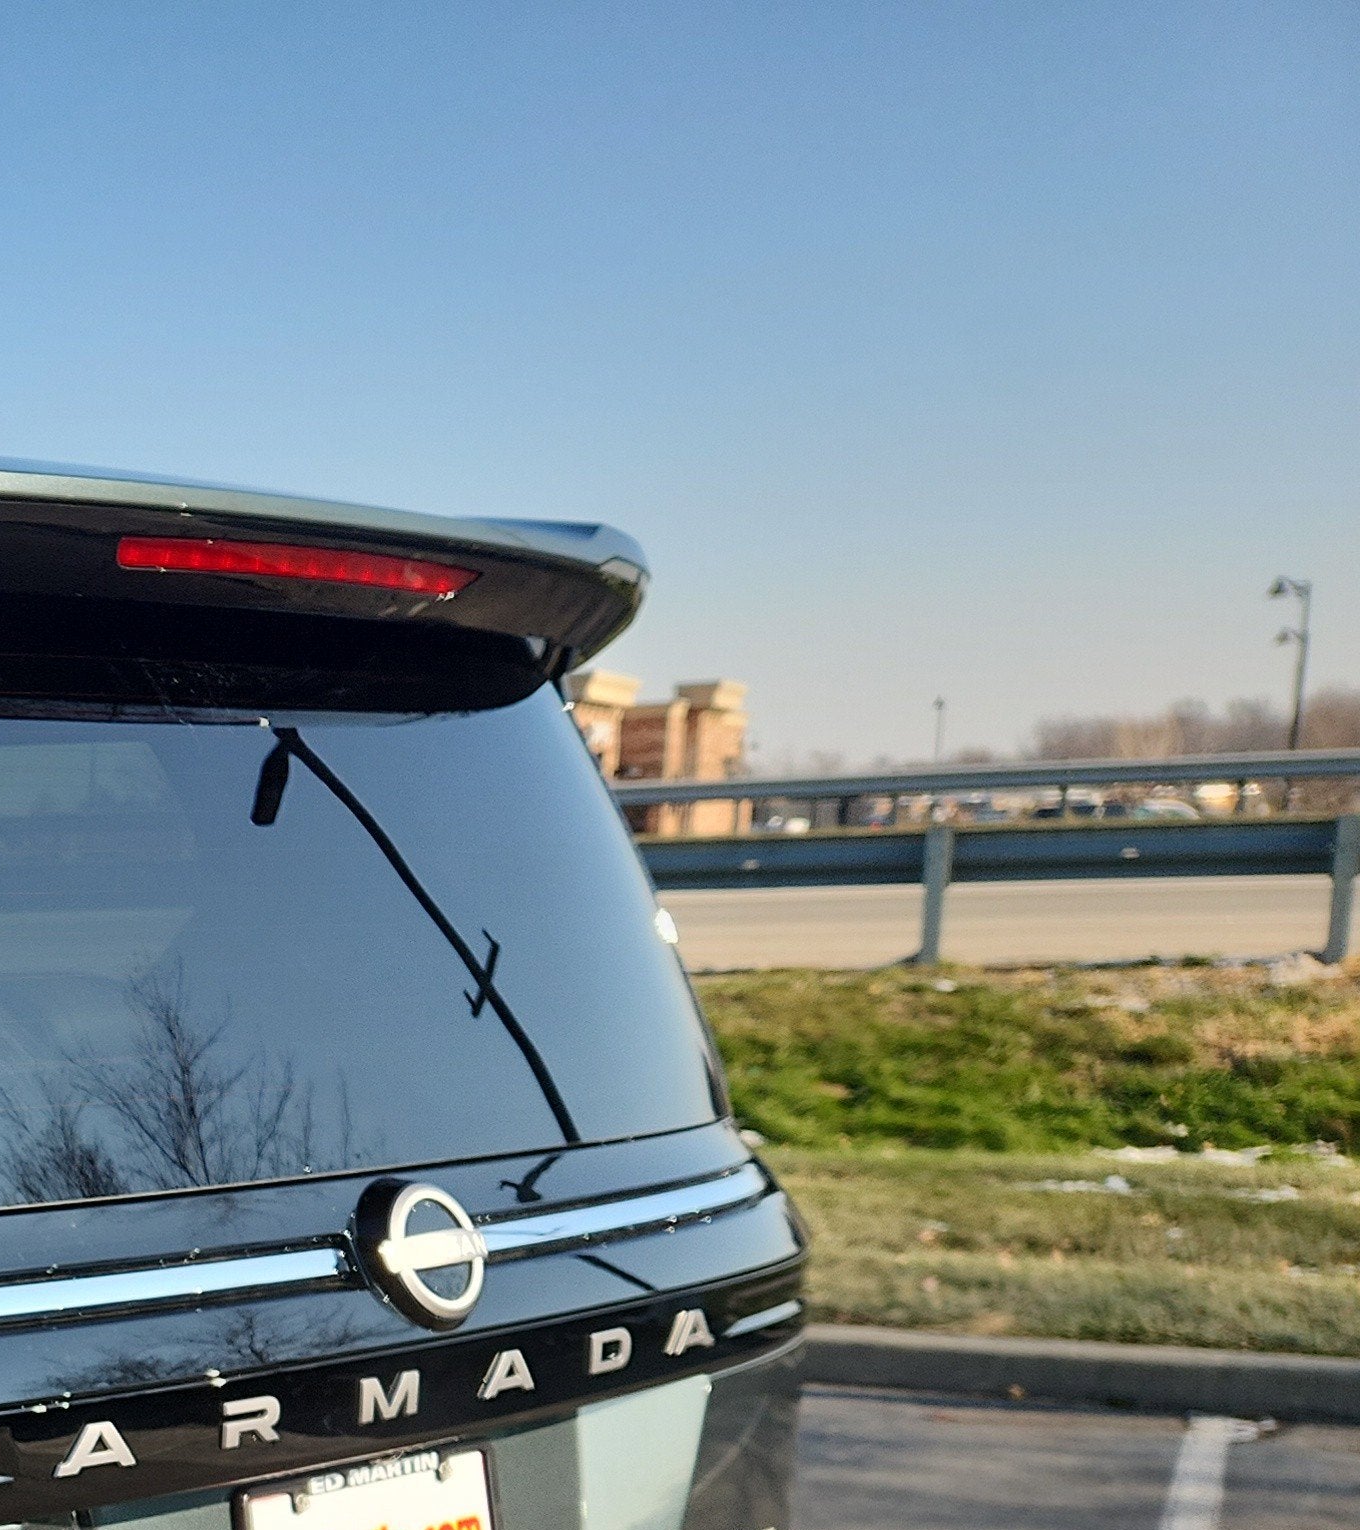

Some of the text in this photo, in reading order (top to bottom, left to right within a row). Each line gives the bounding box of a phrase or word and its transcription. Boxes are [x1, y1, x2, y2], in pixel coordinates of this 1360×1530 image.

[54, 1309, 716, 1478] ARMADA
[308, 1451, 440, 1495] ED MARTIN
